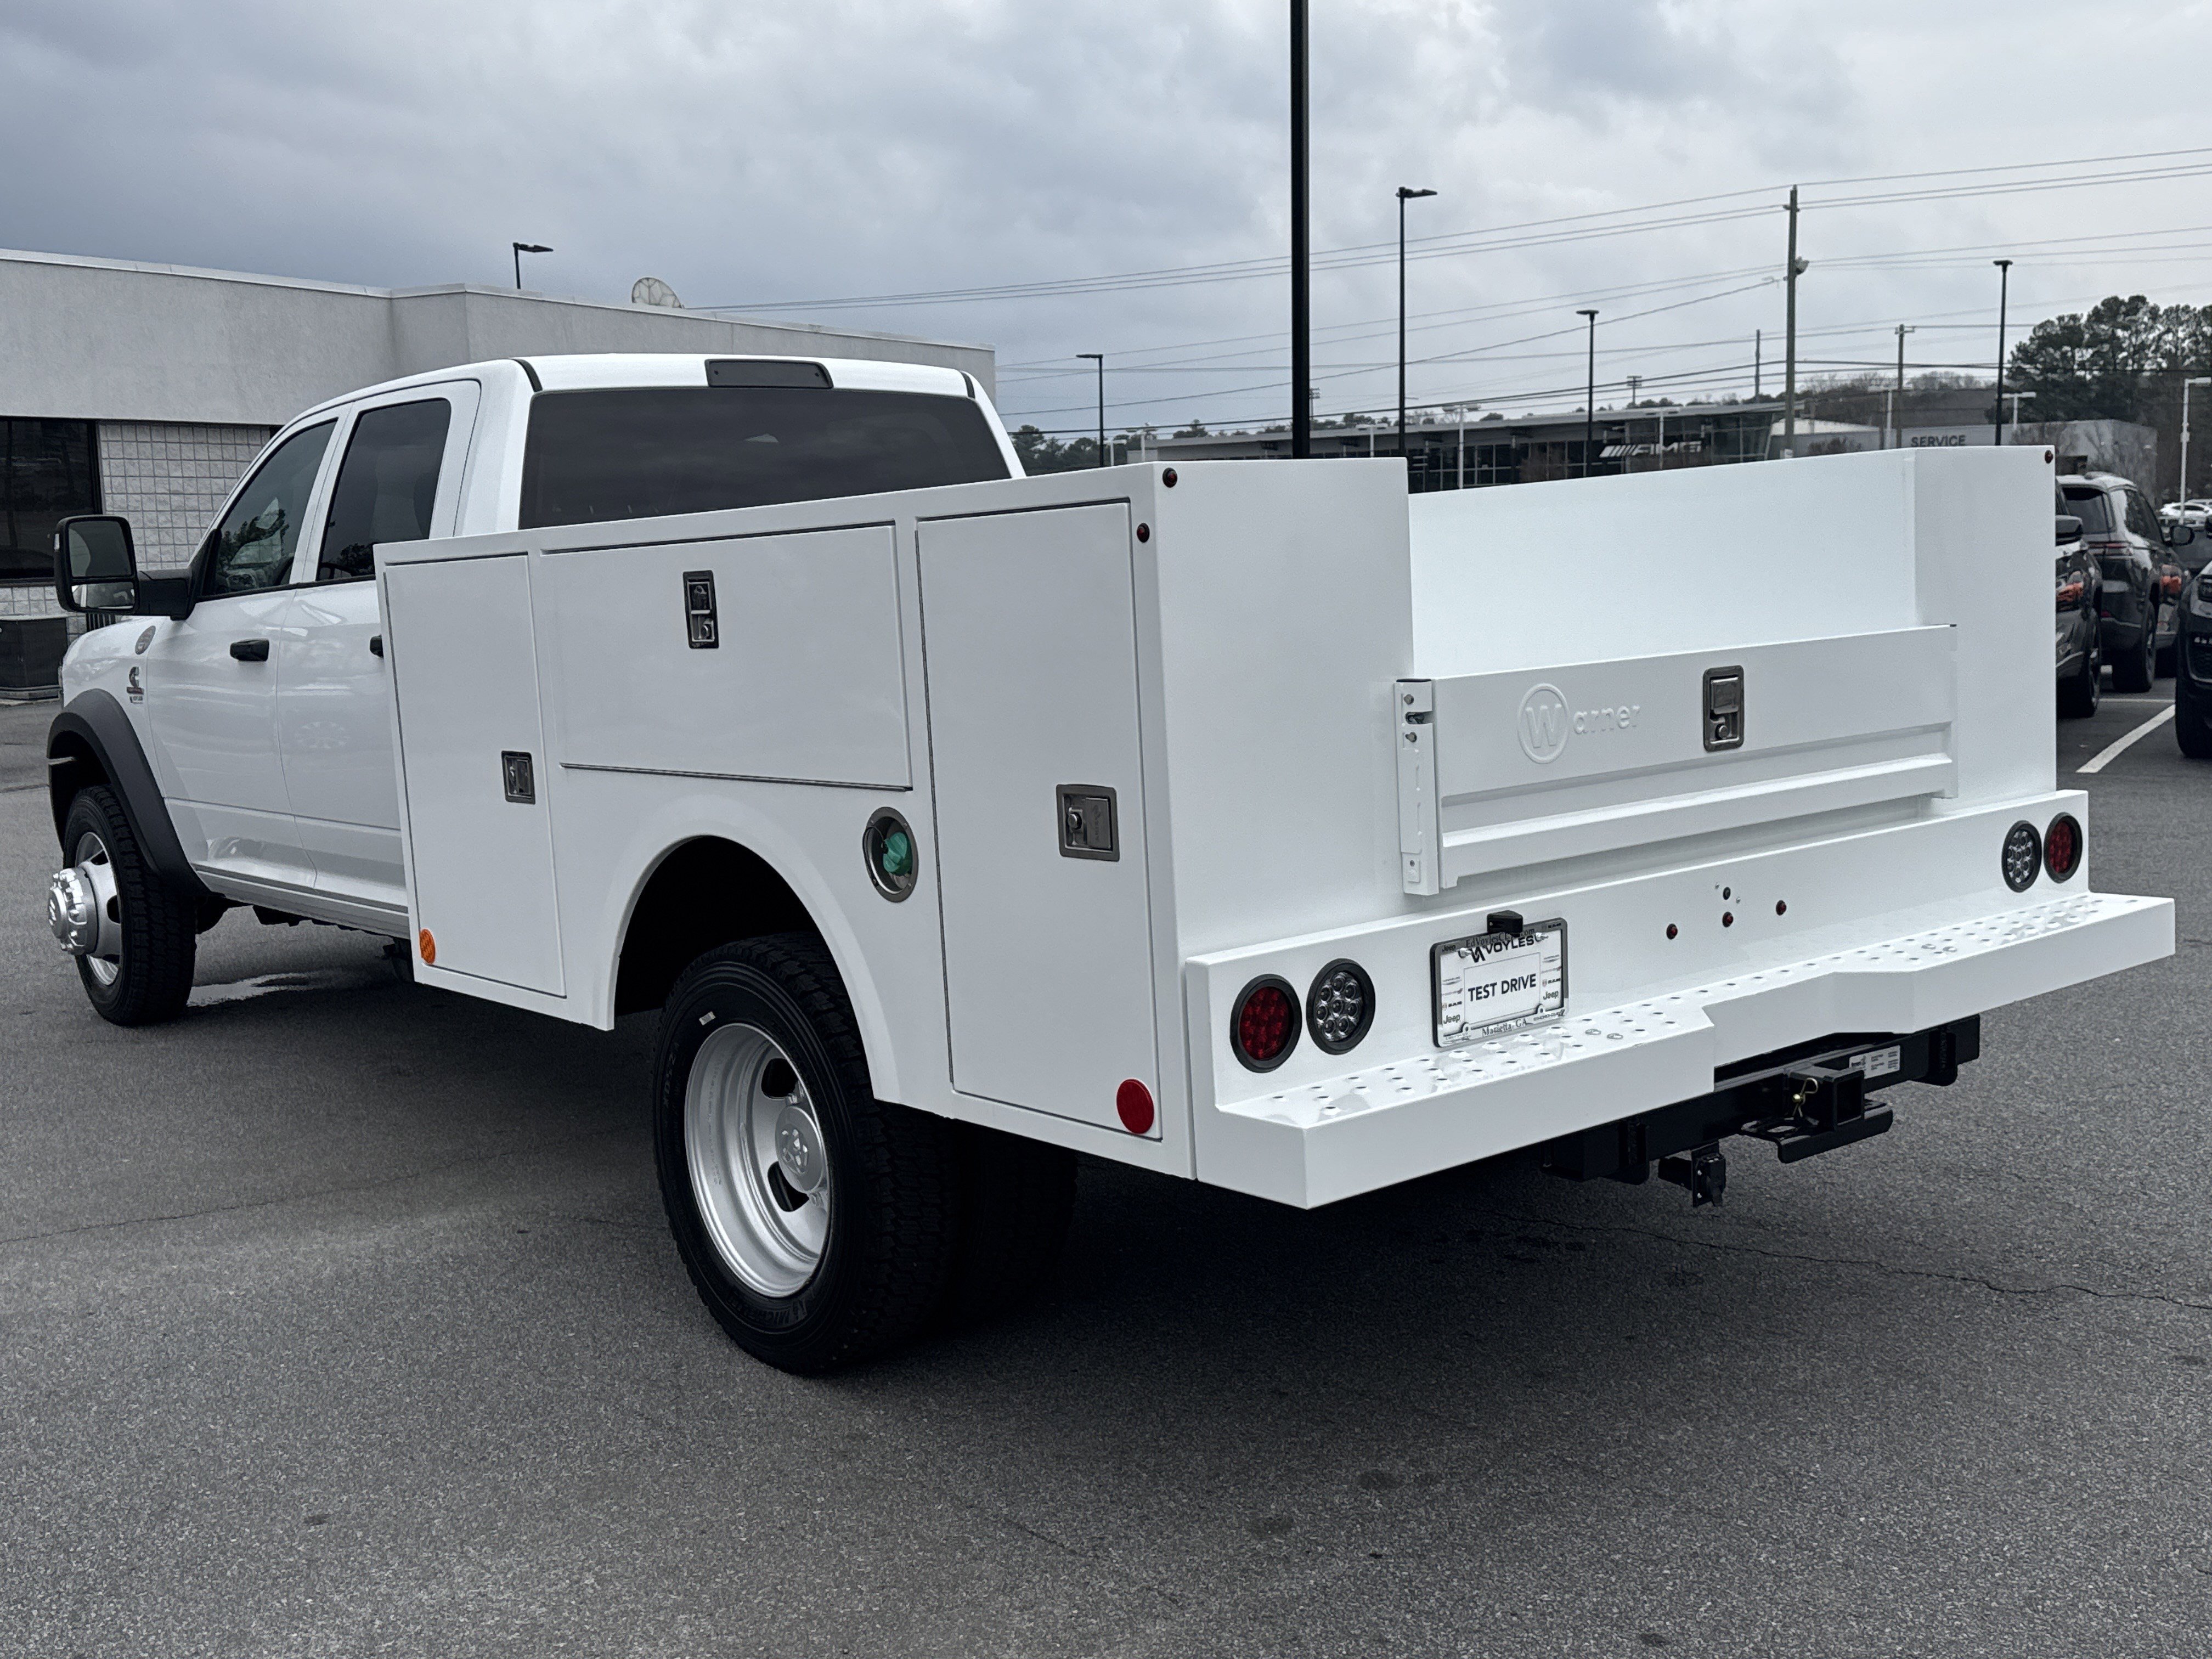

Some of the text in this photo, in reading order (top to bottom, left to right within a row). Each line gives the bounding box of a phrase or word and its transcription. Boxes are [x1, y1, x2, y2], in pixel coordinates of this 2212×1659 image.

[1911, 435, 1966, 447] SERVICE
[1632, 441, 1702, 456] AMG
[1482, 935, 1534, 953] VOYLES
[1468, 973, 1536, 1002] TEST DRIVE
[1543, 990, 1559, 1000] Jeep
[1443, 1014, 1460, 1024] Jeep
